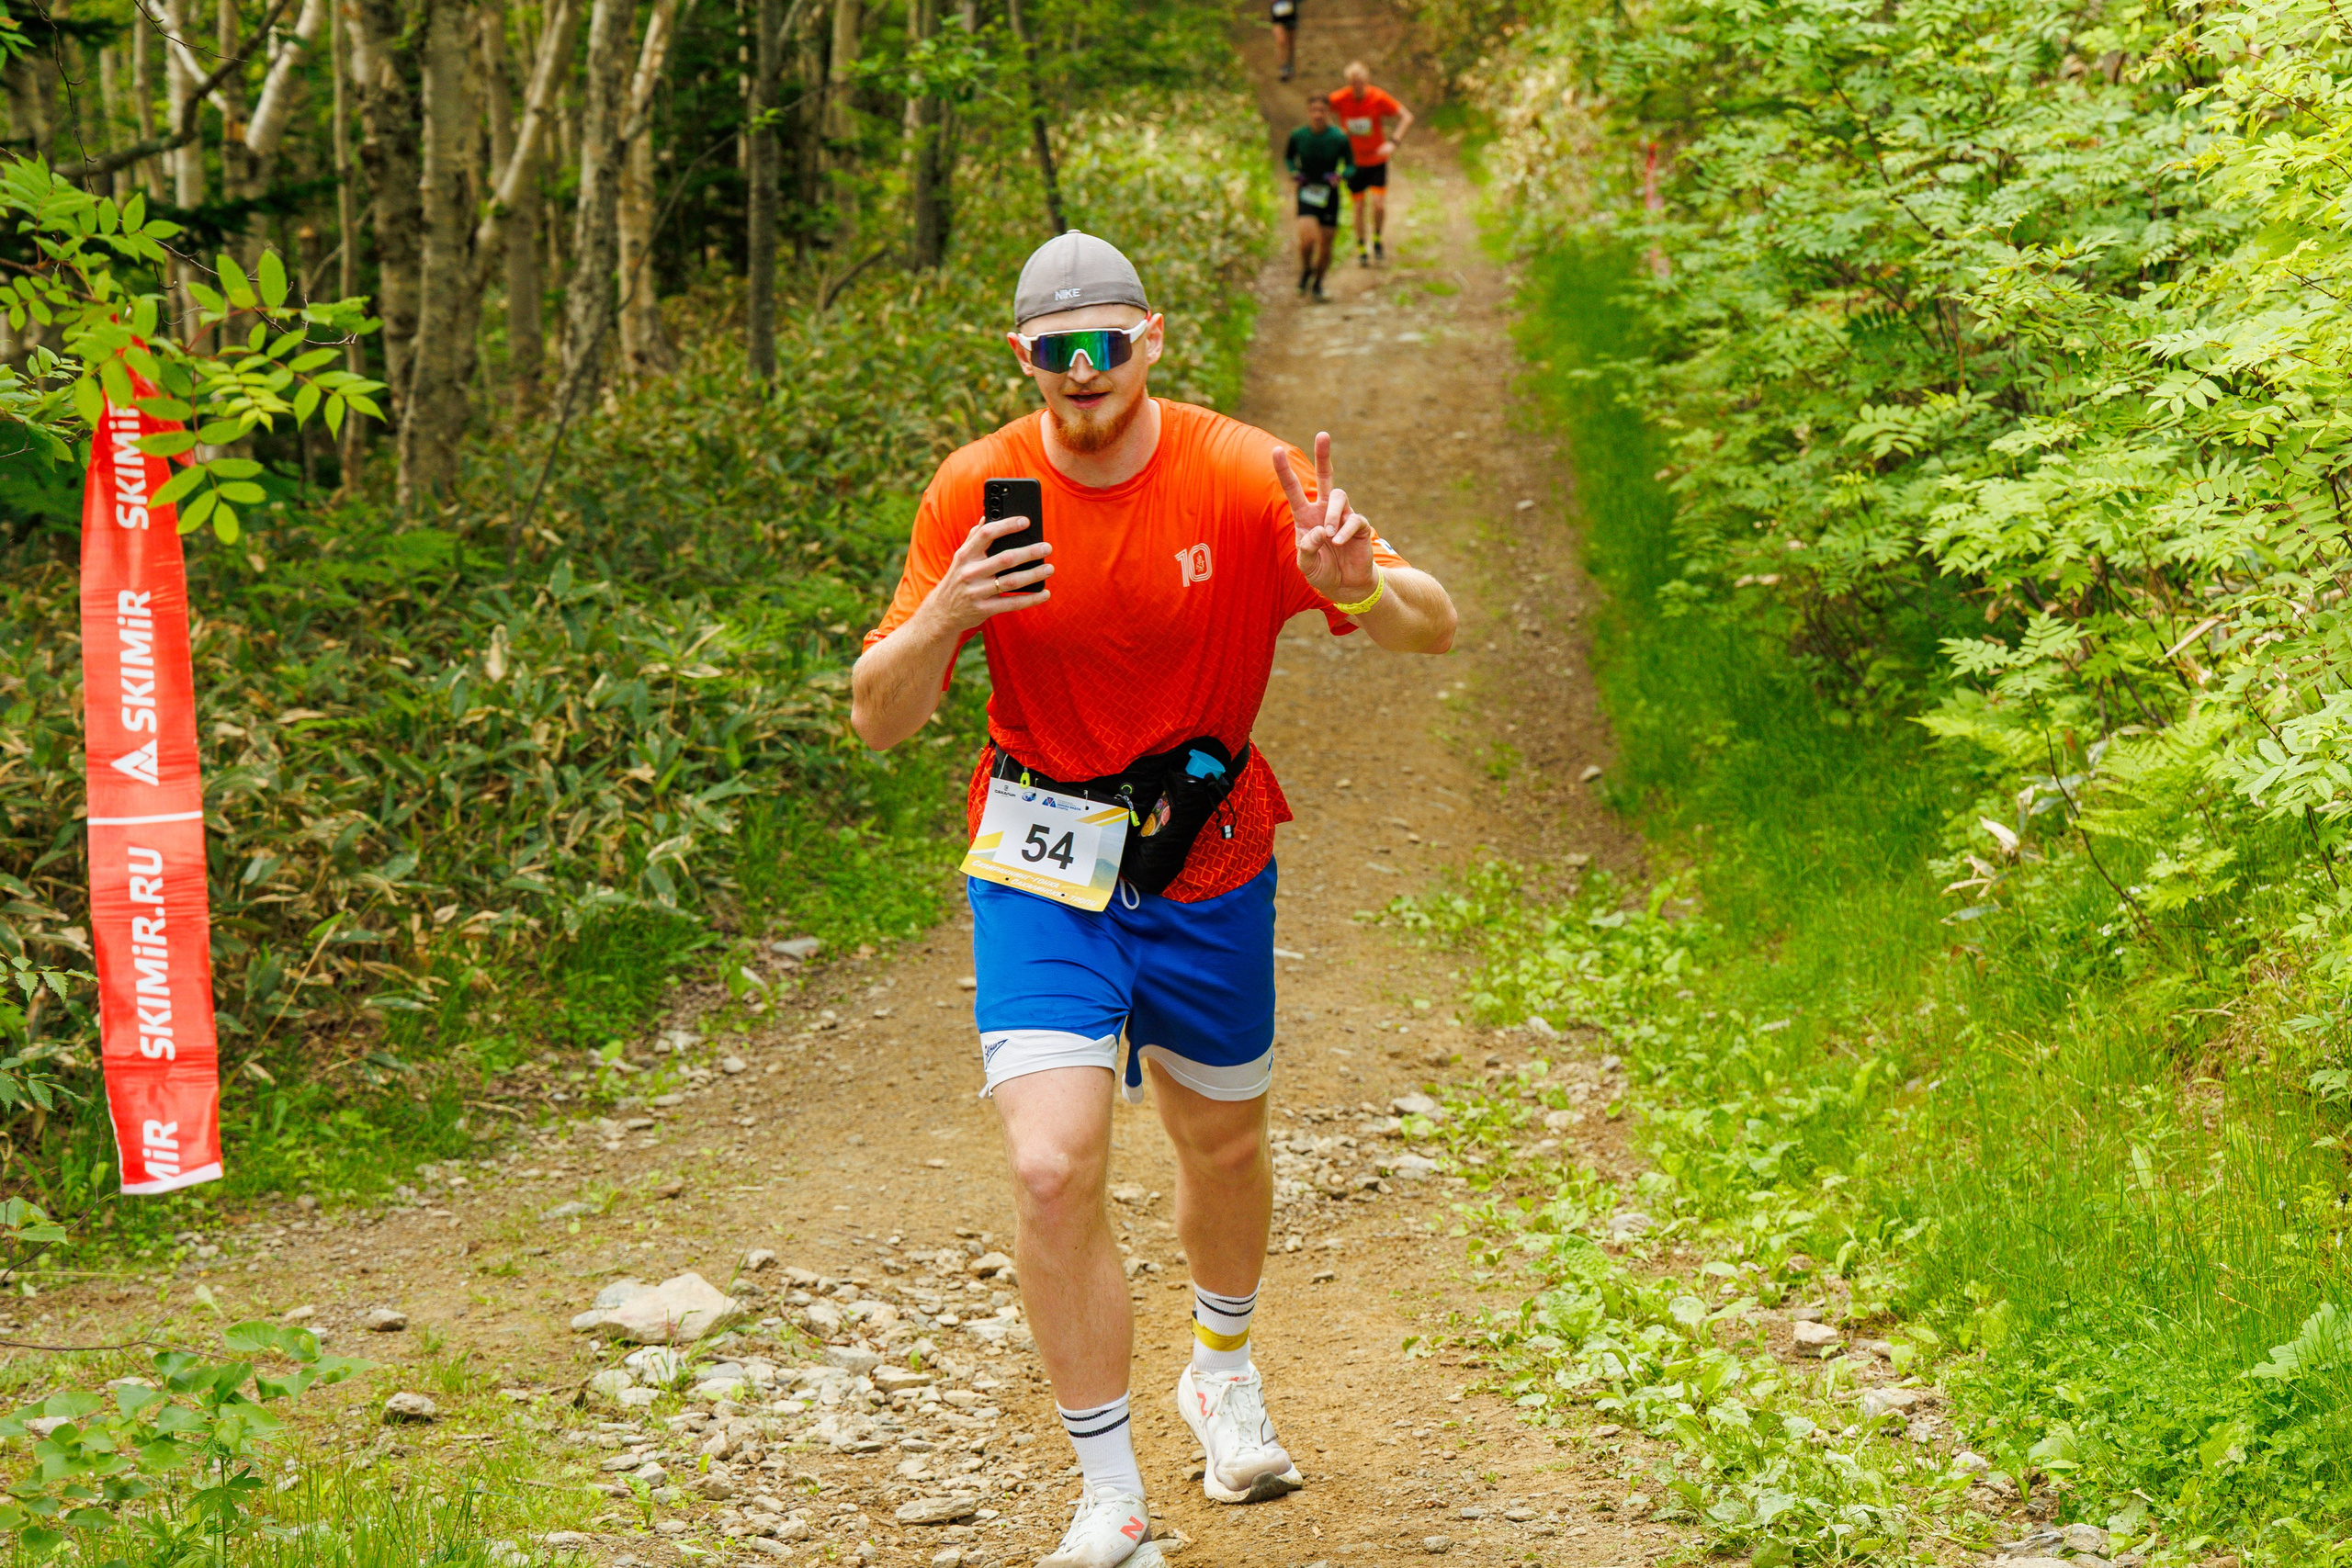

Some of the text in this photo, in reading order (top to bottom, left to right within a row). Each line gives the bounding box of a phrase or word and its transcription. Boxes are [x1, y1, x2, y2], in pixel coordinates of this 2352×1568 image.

[1054, 288, 1081, 301] NIKE
[1173, 542, 1213, 588] 10
[1022, 823, 1074, 871] 54
